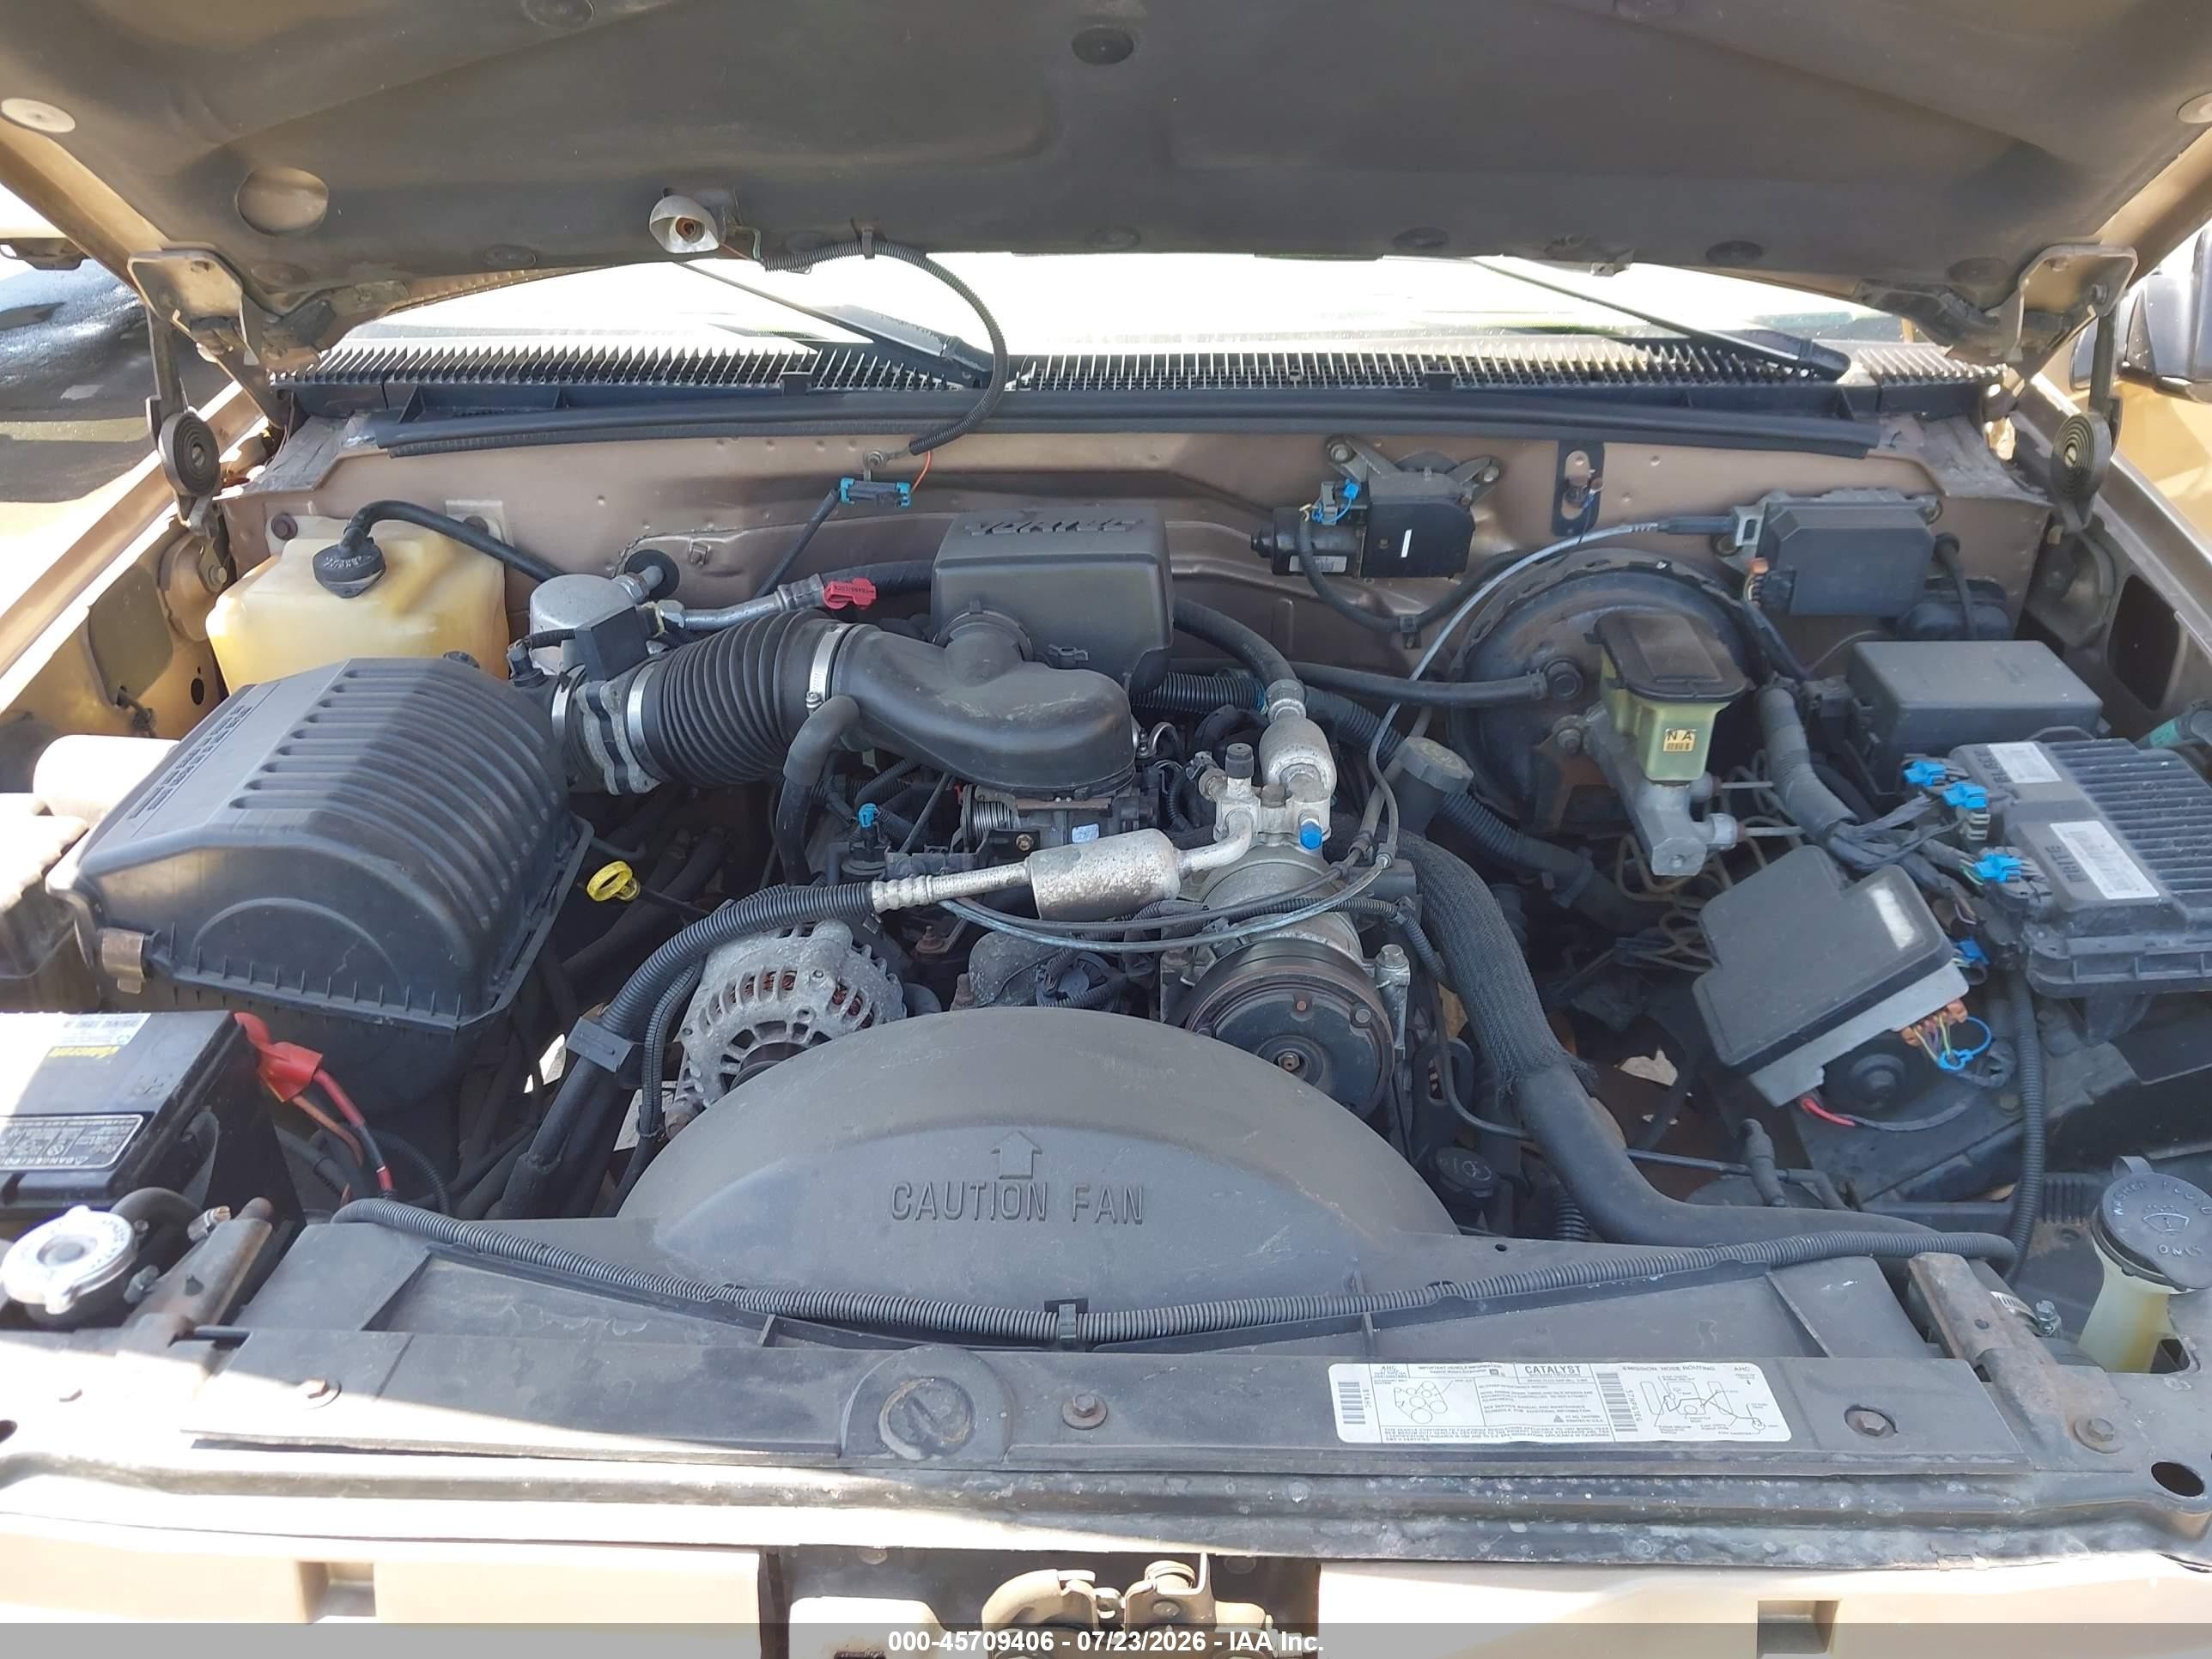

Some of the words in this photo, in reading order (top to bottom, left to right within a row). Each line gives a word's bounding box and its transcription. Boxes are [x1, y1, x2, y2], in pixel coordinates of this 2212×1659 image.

[891, 1181, 1048, 1222] CAUTION
[1073, 1183, 1144, 1225] FAN
[1524, 1365, 1582, 1374] CATALYST
